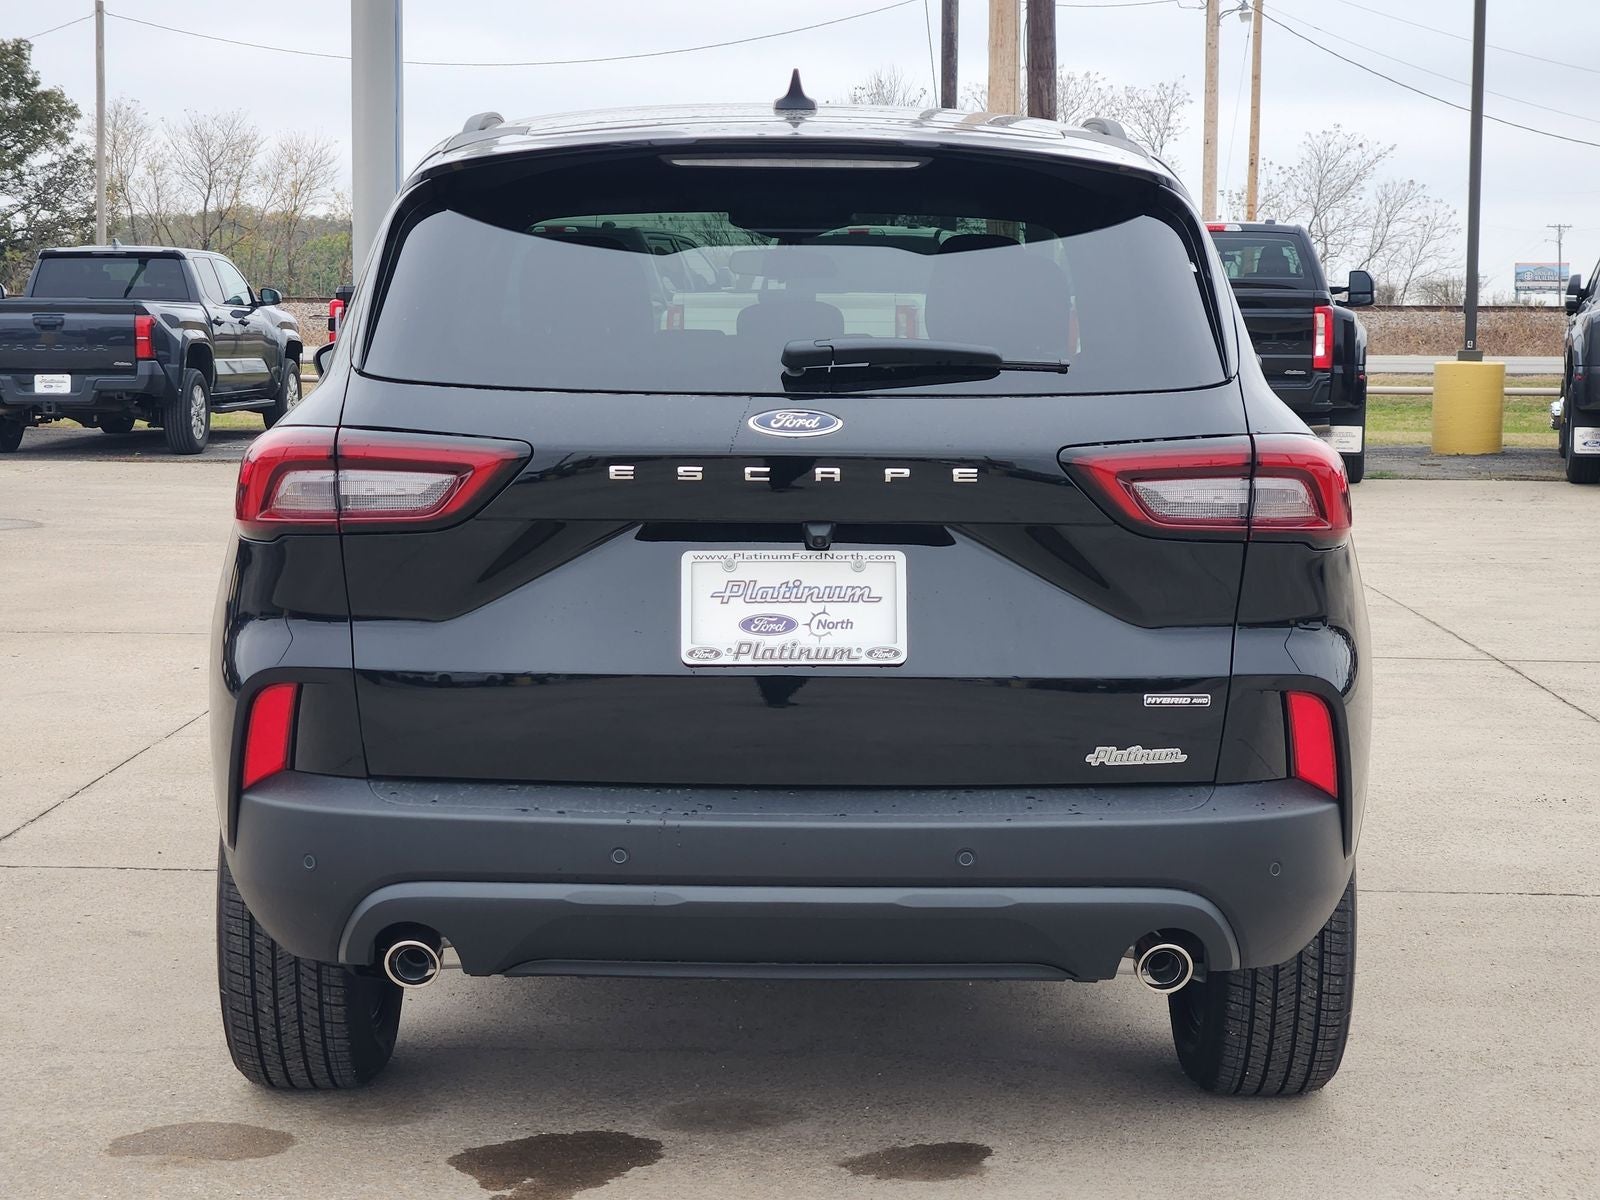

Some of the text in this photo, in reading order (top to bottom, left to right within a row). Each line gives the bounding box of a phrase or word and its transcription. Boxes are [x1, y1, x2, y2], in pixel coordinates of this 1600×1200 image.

[770, 412, 821, 428] Ford
[609, 465, 978, 483] ESCAPE
[693, 552, 896, 561] www.PlatinumFordNorth.com
[710, 579, 883, 605] Platinum
[750, 616, 787, 632] Ford
[816, 618, 854, 630] North
[726, 640, 862, 661] Platinum
[1086, 745, 1188, 766] Platinum
